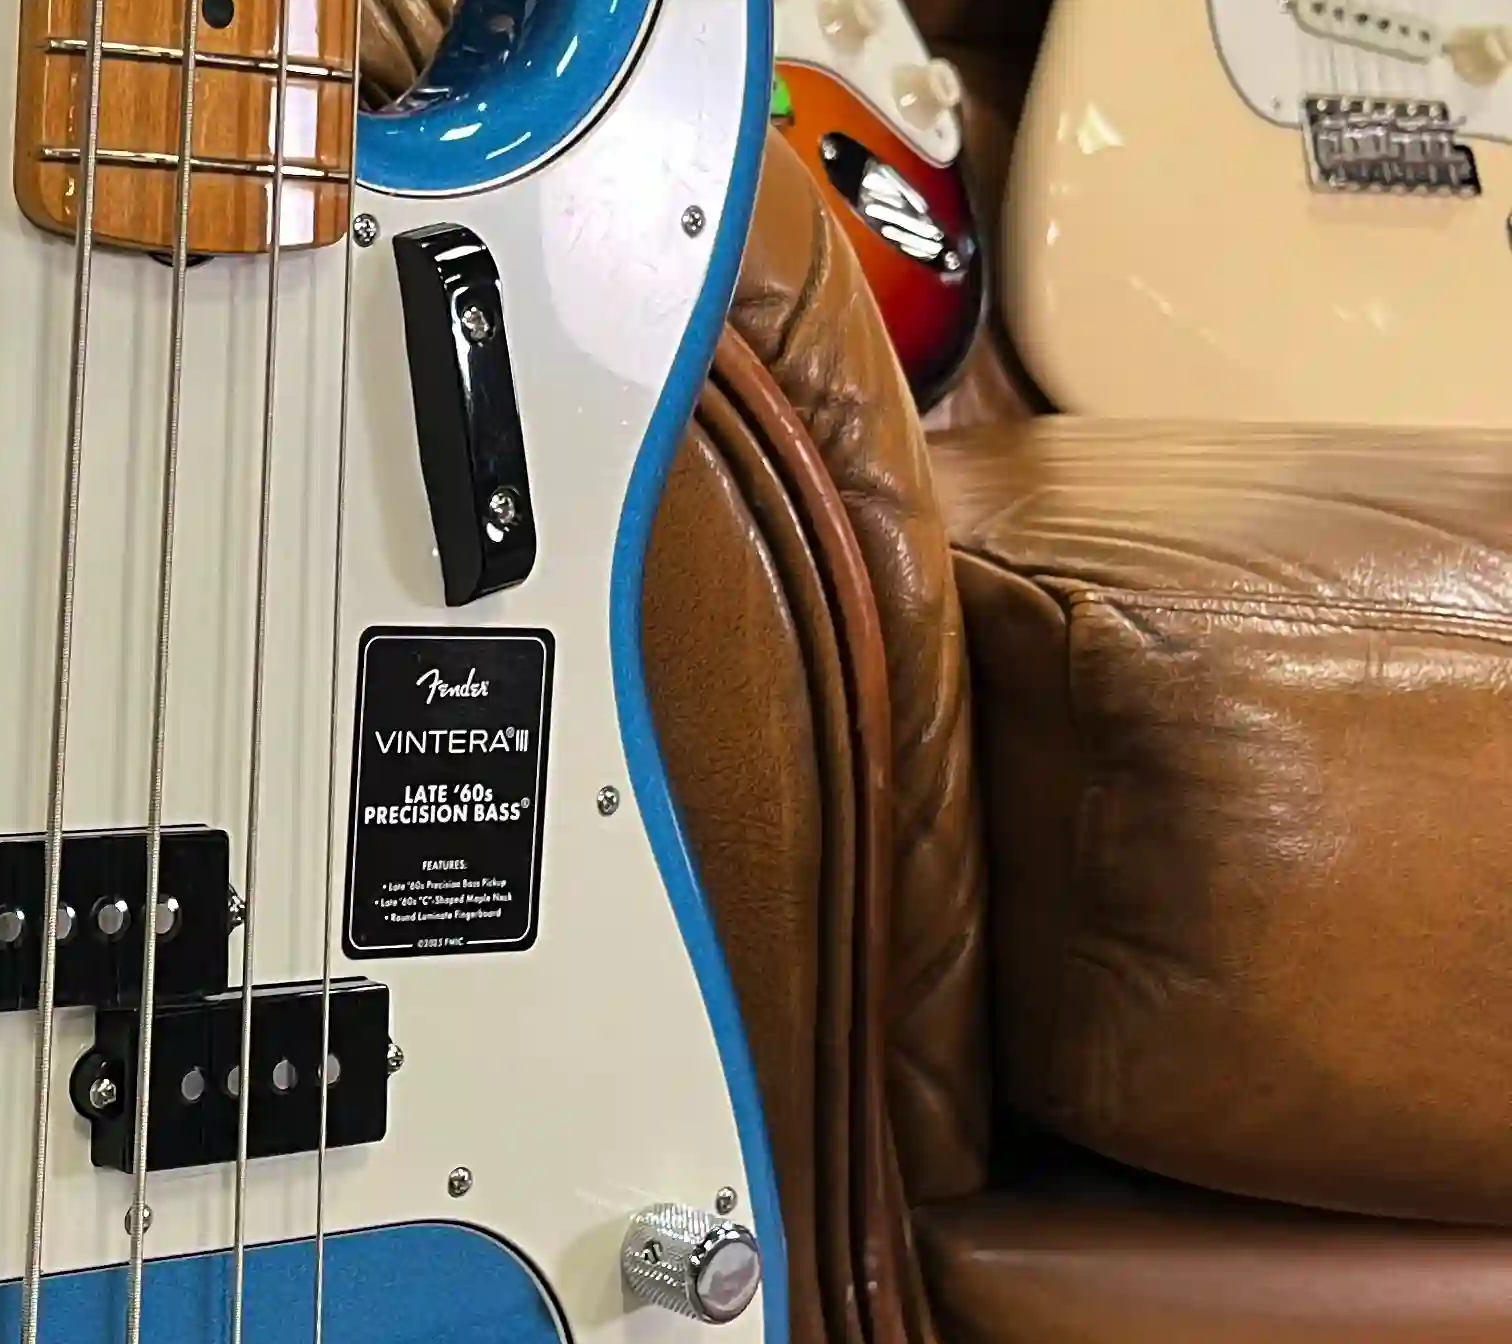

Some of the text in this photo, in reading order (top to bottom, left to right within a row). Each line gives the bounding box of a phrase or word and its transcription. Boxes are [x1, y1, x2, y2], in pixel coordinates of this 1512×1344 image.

[415, 666, 490, 705] Fender
[403, 783, 494, 805] LATE '60s
[363, 804, 469, 826] PRECISION
[421, 859, 469, 872] FEATURES:
[482, 876, 507, 888] Pickup
[390, 912, 417, 923] Round
